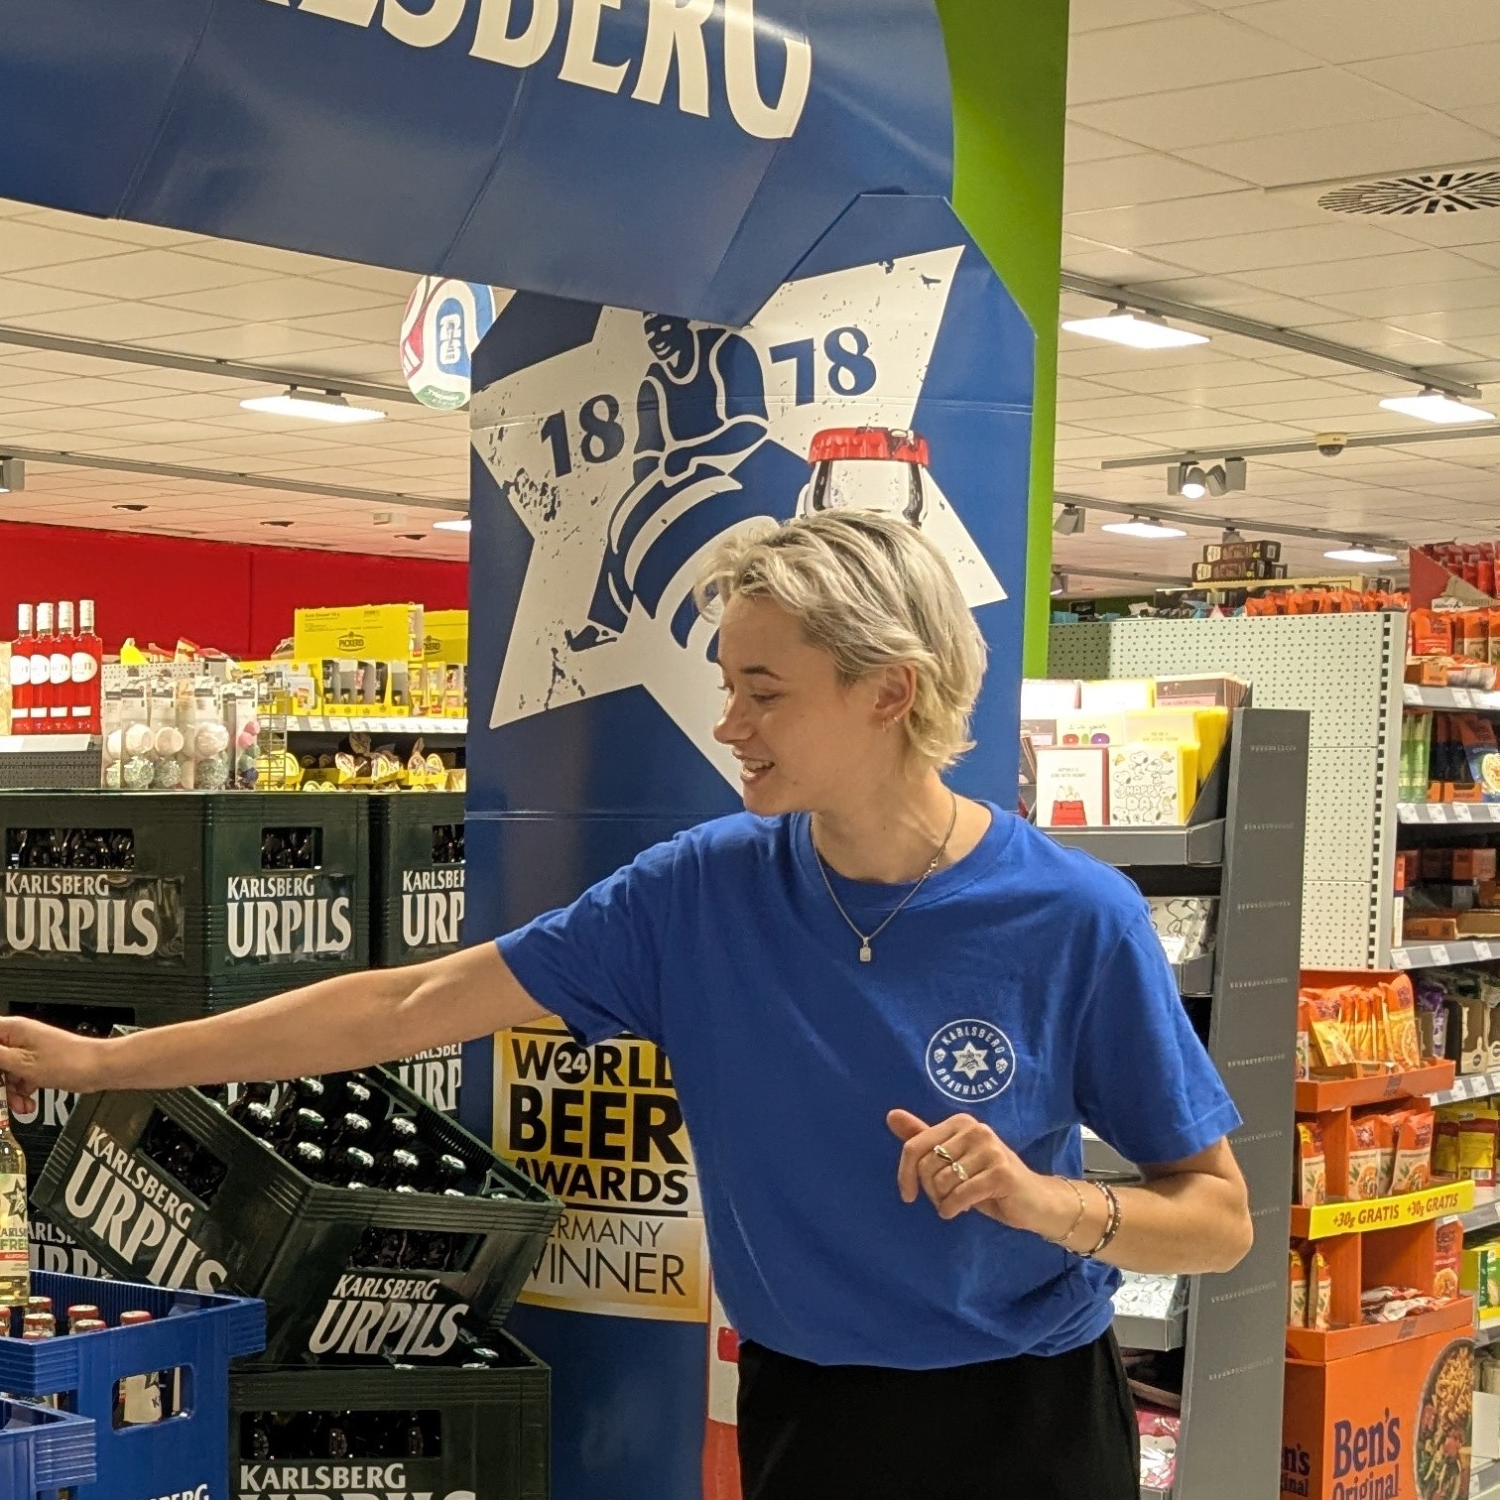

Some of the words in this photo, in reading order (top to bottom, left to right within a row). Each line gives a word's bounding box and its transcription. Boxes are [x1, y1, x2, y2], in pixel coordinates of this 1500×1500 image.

[540, 393, 627, 478] 18
[769, 326, 878, 408] 78
[1125, 785, 1163, 798] HAPPY
[1125, 797, 1161, 811] DAY
[6, 871, 110, 896] KARLSBERG
[227, 875, 315, 900] KARLSBERG
[5, 897, 159, 957] URPILS
[227, 897, 352, 958] URPILS
[402, 893, 465, 946] URP
[557, 1050, 588, 1075] 24
[941, 1026, 1006, 1054] KARLSBERG
[509, 1083, 689, 1165] BEER
[86, 1125, 195, 1231] KARLSBERG
[63, 1150, 229, 1296] URPILS
[1332, 1211, 1356, 1230] +30g
[1357, 1204, 1400, 1226] GRATIS
[1425, 1193, 1459, 1213] GRATIS
[332, 1274, 441, 1300] KARLSBERG
[308, 1299, 470, 1356] URPILS
[1332, 1406, 1401, 1480] Ben's
[239, 1463, 406, 1491] KARLSBERG
